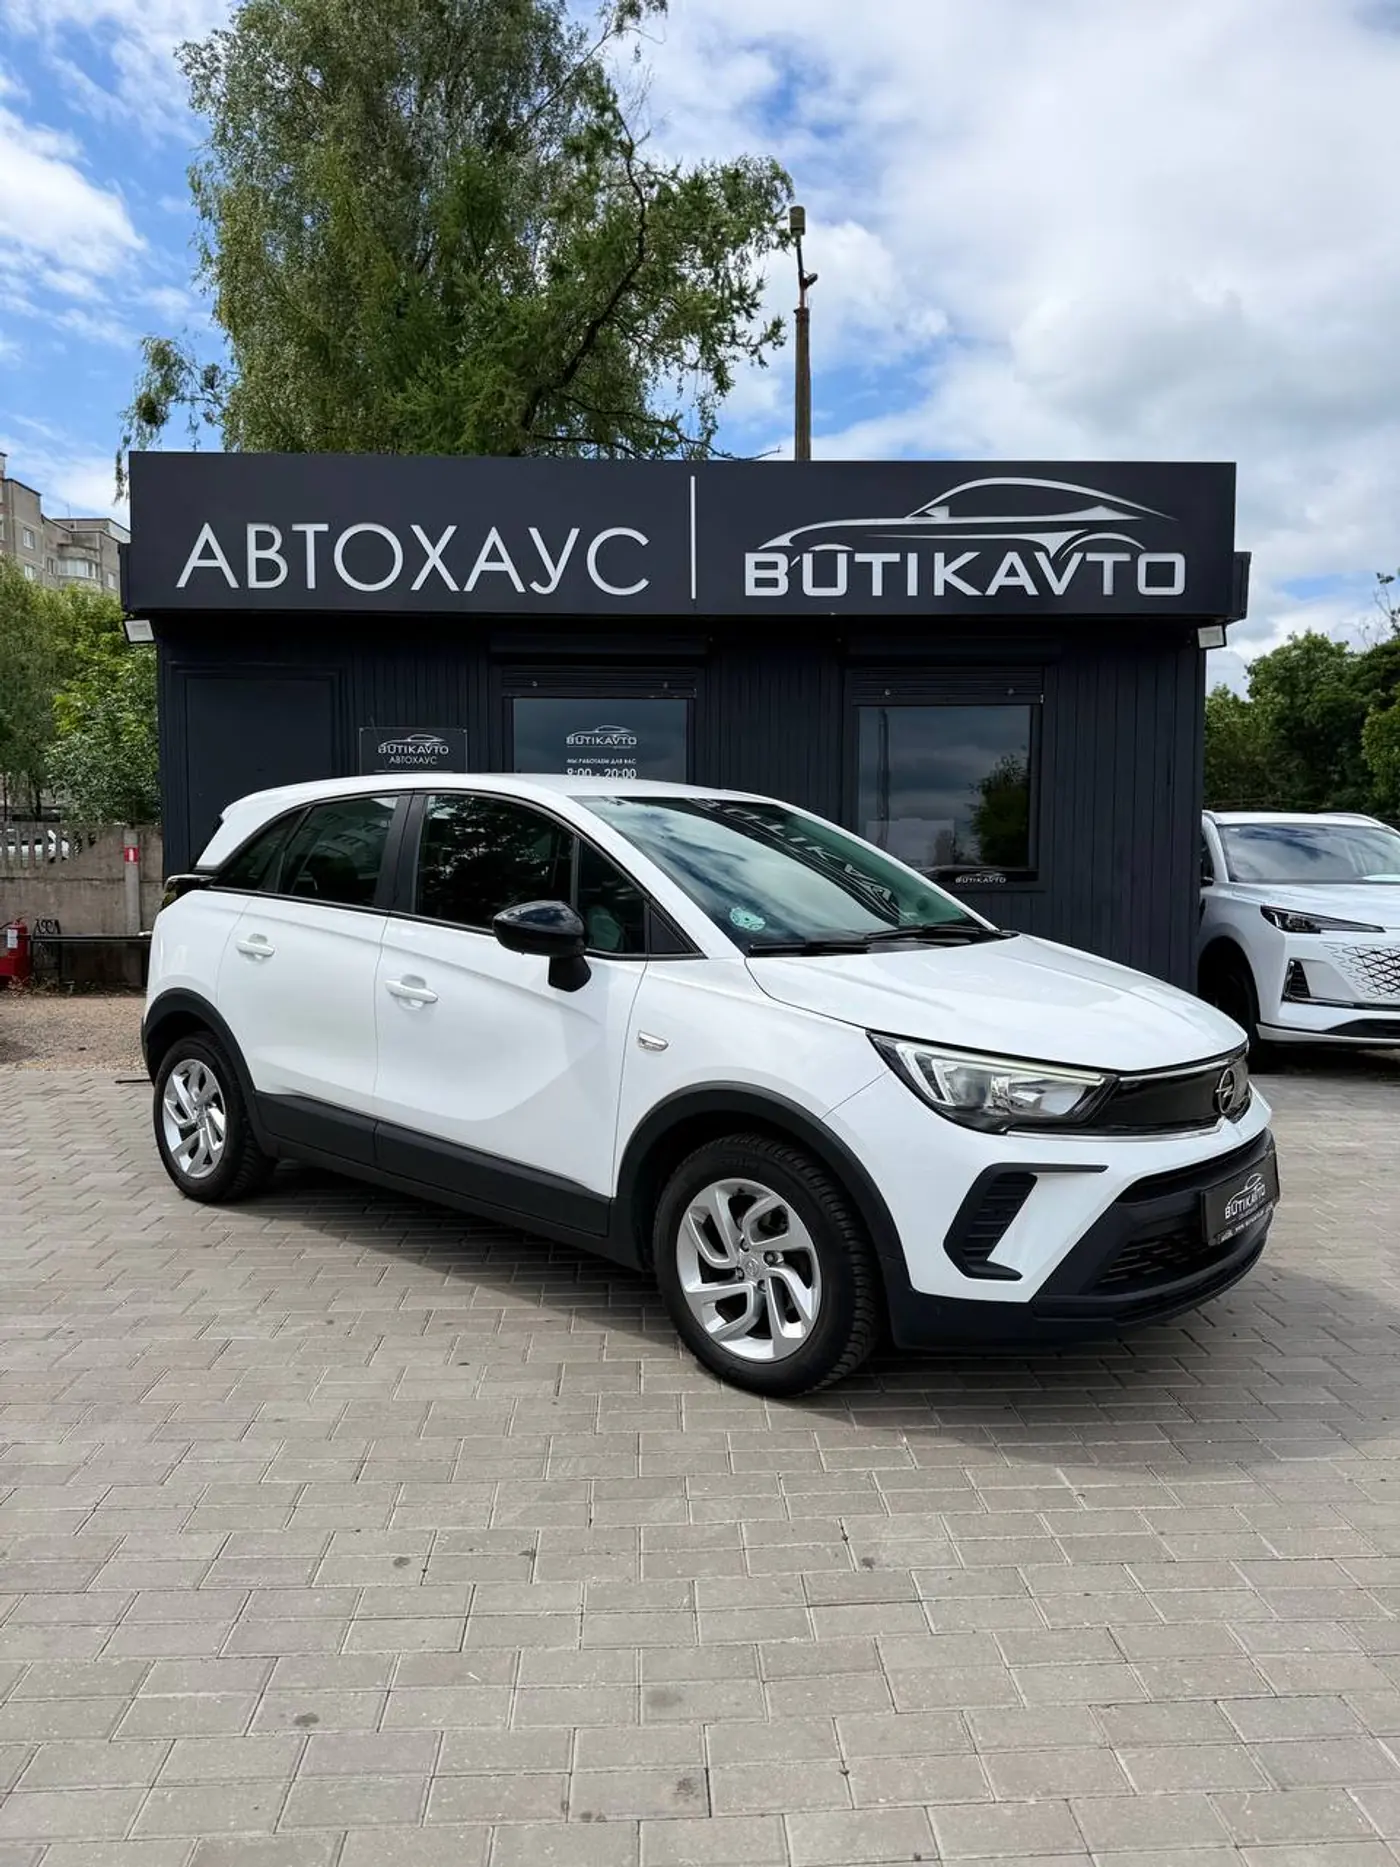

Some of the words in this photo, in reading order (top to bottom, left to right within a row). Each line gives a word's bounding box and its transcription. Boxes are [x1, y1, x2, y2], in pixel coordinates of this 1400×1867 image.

[175, 521, 650, 596] АВТОХАУС
[744, 551, 1186, 596] BUTIKAVTO
[565, 735, 637, 745] BUTIKAVTO
[377, 743, 449, 755] BUTIKAVTO
[388, 755, 437, 765] АВТОХАУС
[604, 768, 637, 779] 20:00
